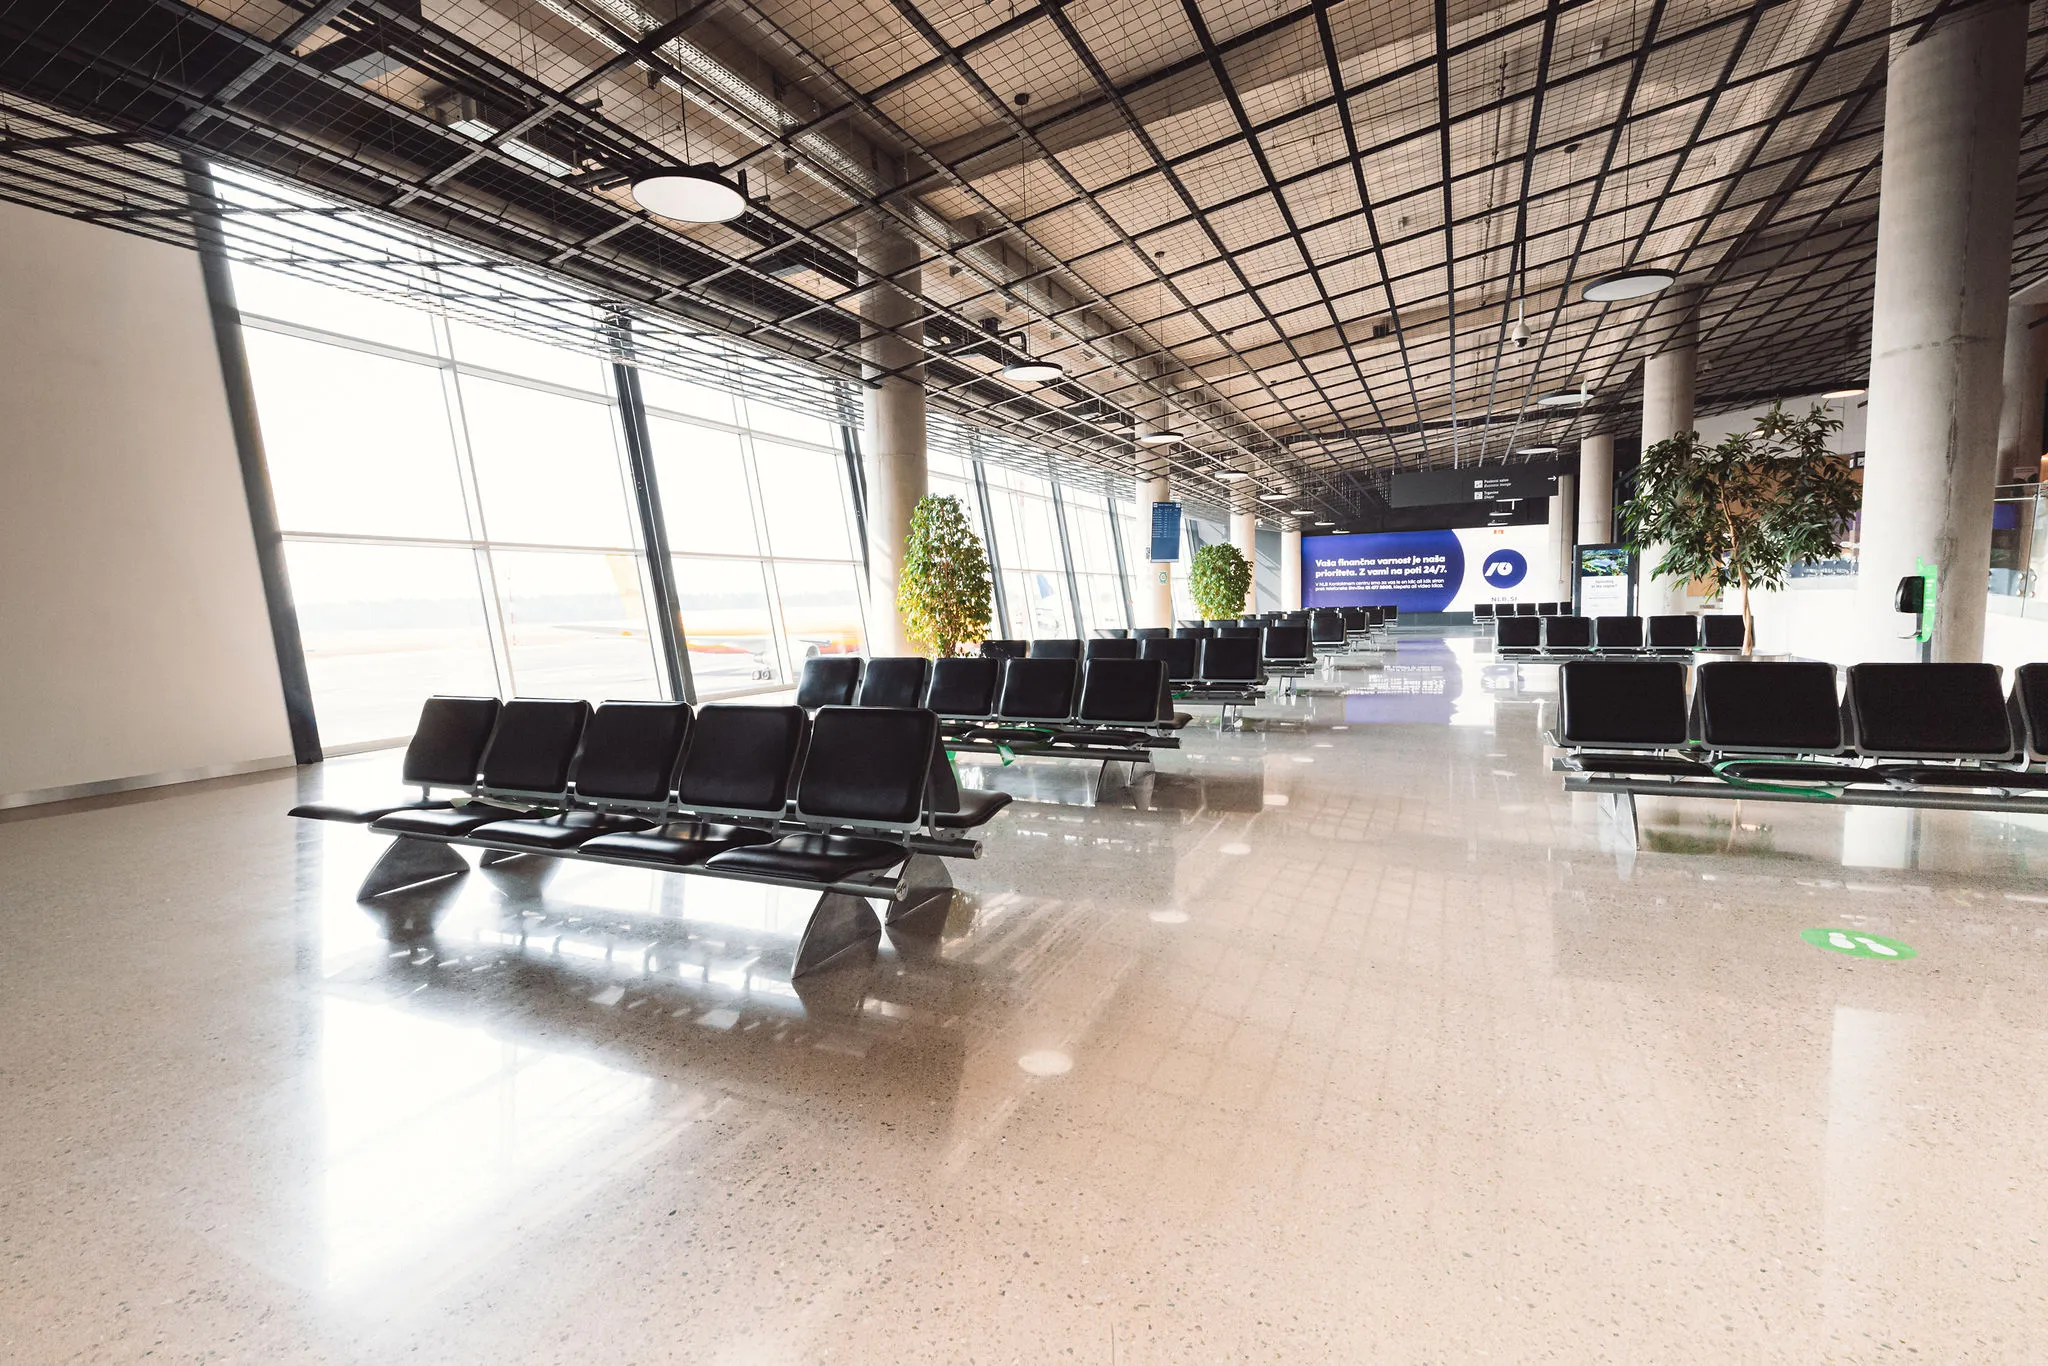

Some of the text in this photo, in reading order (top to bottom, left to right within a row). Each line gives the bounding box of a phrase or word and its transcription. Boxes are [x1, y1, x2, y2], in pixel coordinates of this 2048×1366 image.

[1315, 555, 1445, 567] Vaša finančna varnost je naša
[1315, 568, 1357, 578] prioriteta.
[1367, 567, 1389, 575] vami
[1404, 566, 1422, 576] poti
[1423, 565, 1447, 574] 24/7.
